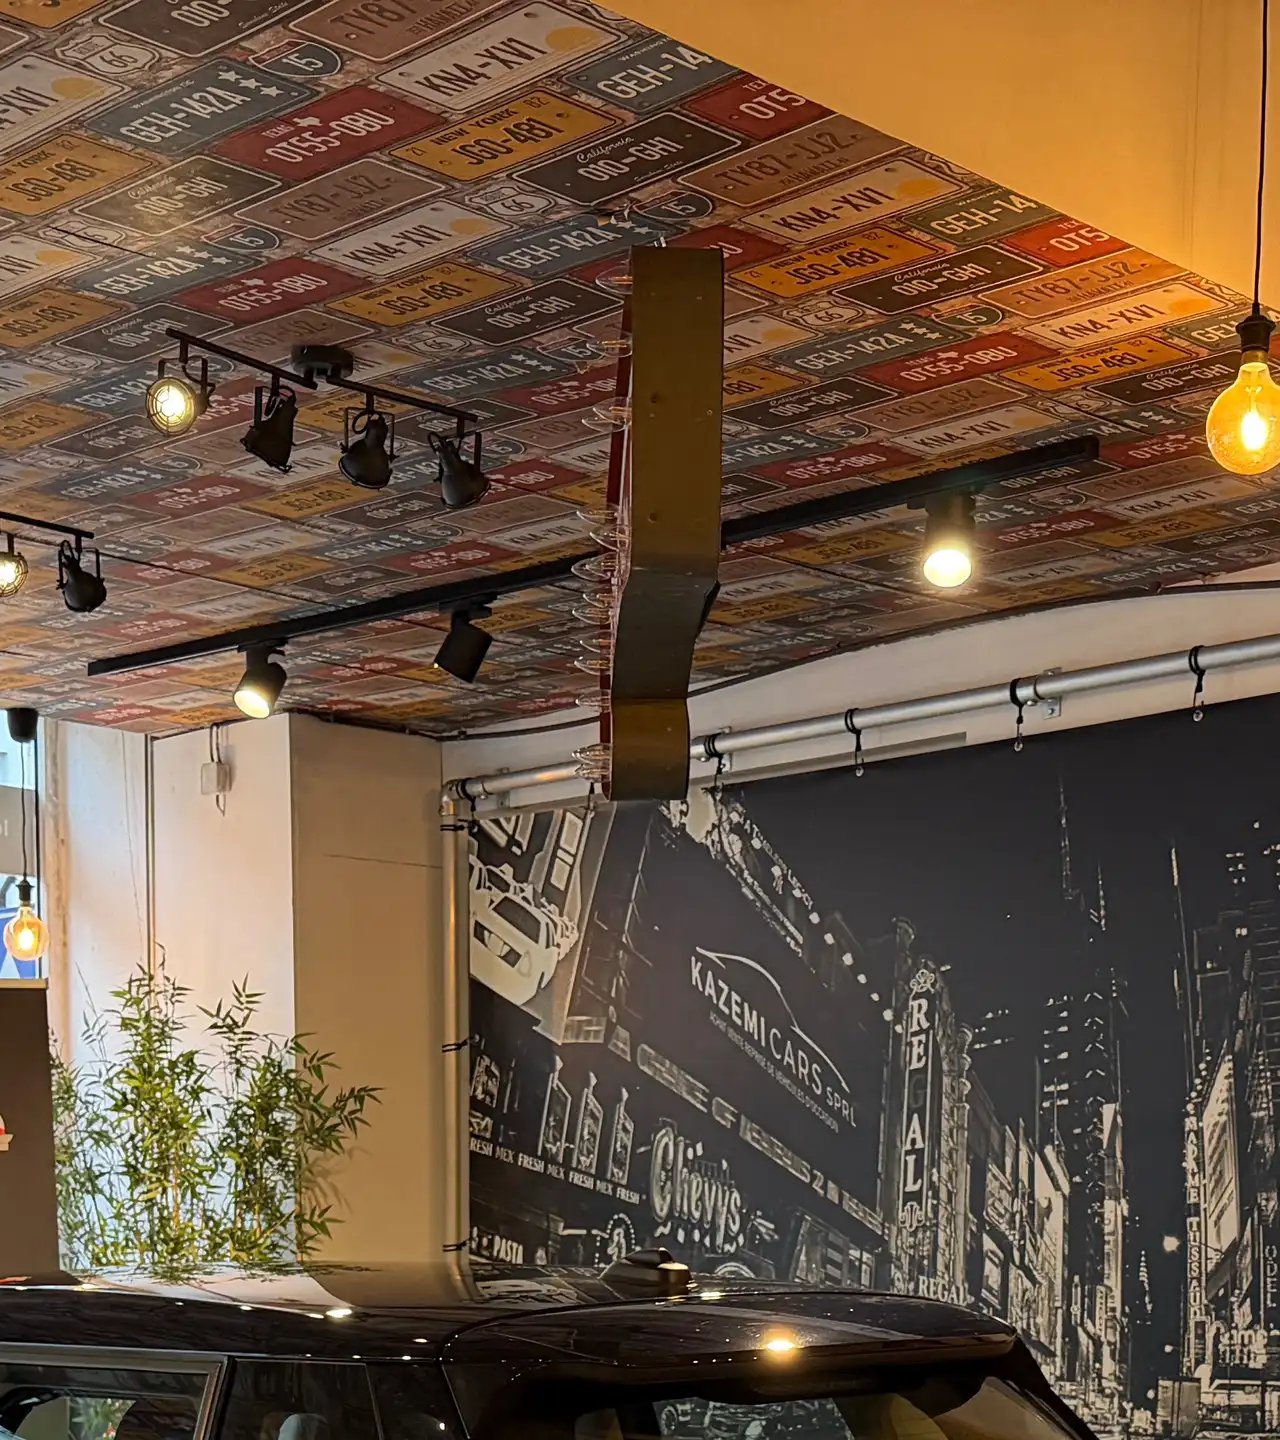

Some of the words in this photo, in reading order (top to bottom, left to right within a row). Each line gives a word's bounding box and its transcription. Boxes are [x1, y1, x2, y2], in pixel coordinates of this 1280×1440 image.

[281, 53, 325, 70] 15
[661, 201, 698, 214] 15
[228, 233, 265, 246] 15
[956, 312, 989, 323] 15
[690, 956, 766, 1048] KAZEMI
[770, 1028, 822, 1095] CARS
[826, 1086, 857, 1128] SPRL
[519, 1153, 544, 1173] FRESH
[569, 1171, 594, 1191] FRESH
